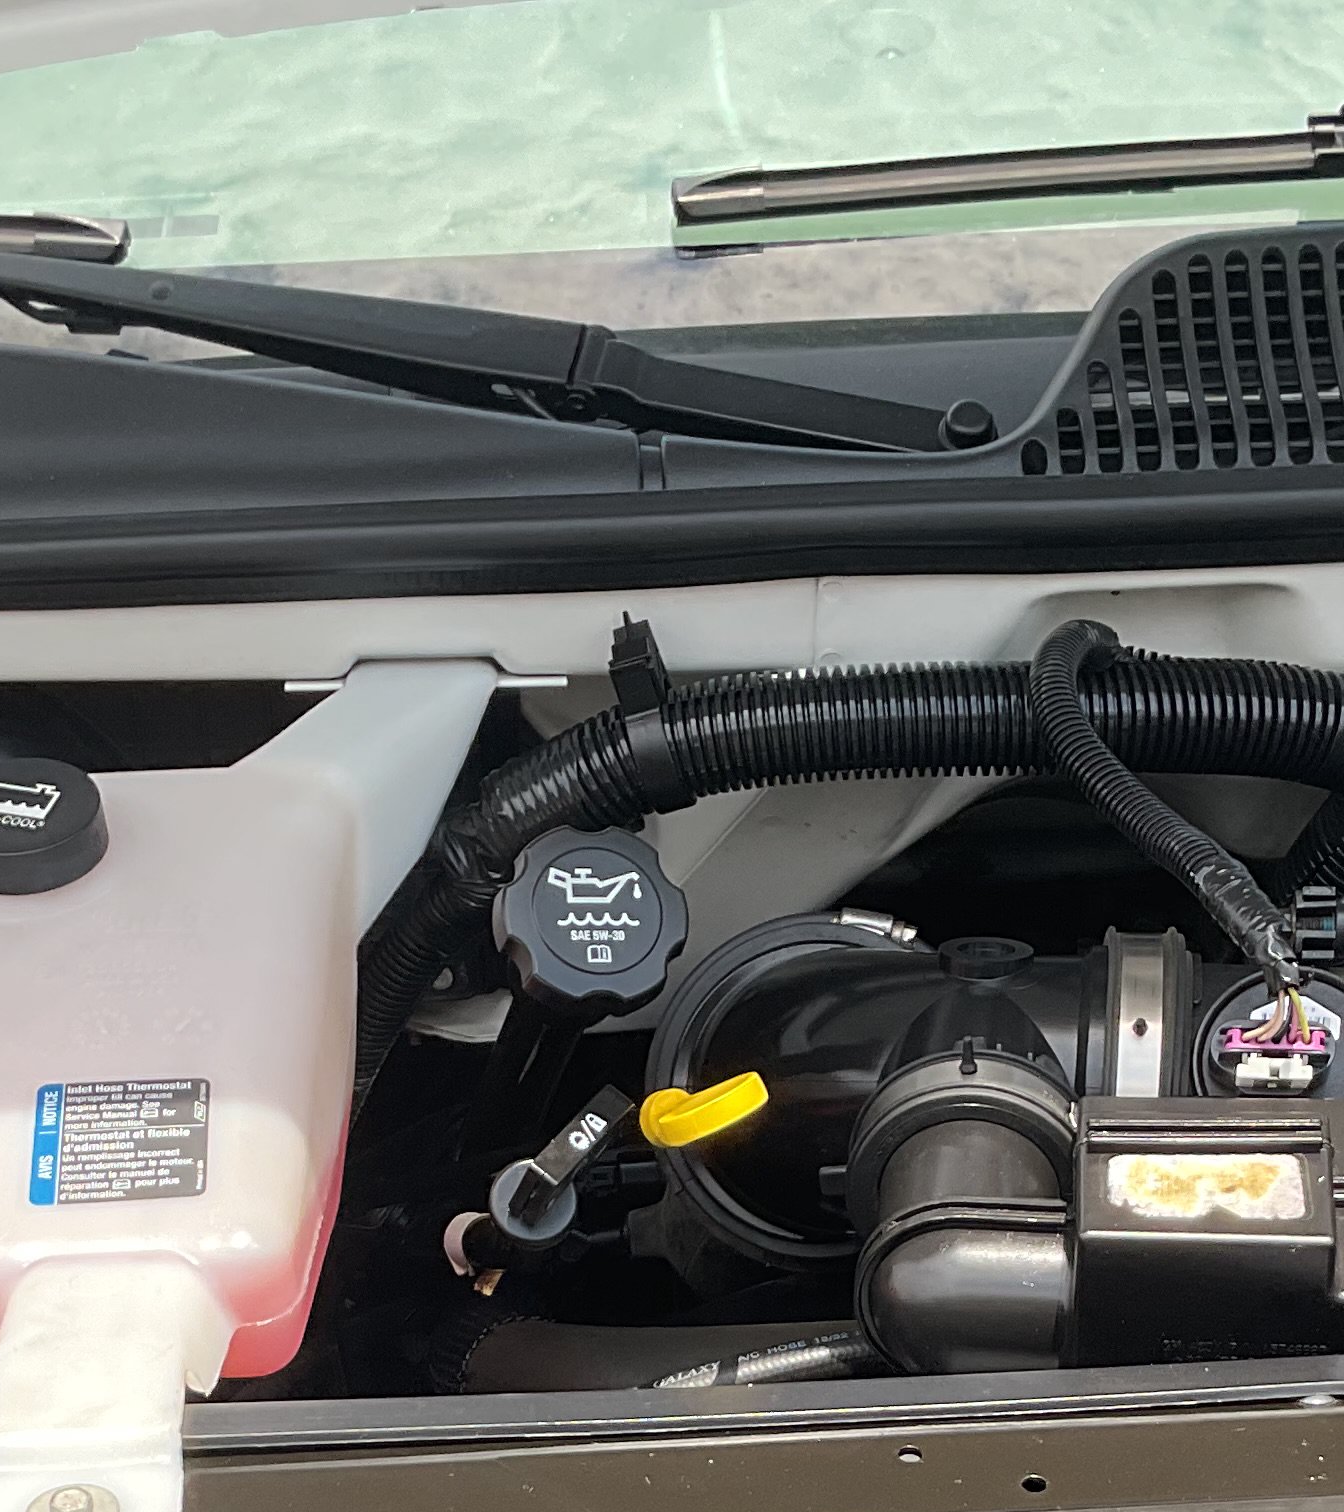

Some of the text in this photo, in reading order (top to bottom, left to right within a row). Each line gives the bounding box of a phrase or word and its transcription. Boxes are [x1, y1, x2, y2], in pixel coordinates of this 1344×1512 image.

[570, 929, 626, 941] SAE 5W-30
[67, 1085, 93, 1094] Inlet
[96, 1083, 124, 1093] Hose
[126, 1081, 192, 1092] Thermostat
[144, 1092, 173, 1100] cause
[42, 1090, 59, 1127] NOTICE
[65, 1103, 98, 1113] engine
[142, 1100, 161, 1109] See
[64, 1108, 177, 1122] Service Manual for
[64, 1121, 89, 1130] more
[64, 1127, 191, 1142] Thermostat et flexible
[62, 1140, 135, 1153] d'admission
[137, 1148, 181, 1158] incorrect
[37, 1154, 54, 1179] AVIS
[60, 1170, 107, 1181] Consulter
[119, 1168, 156, 1178] manuel
[134, 1178, 157, 1189] pour
[767, 1339, 807, 1355] HOSE
